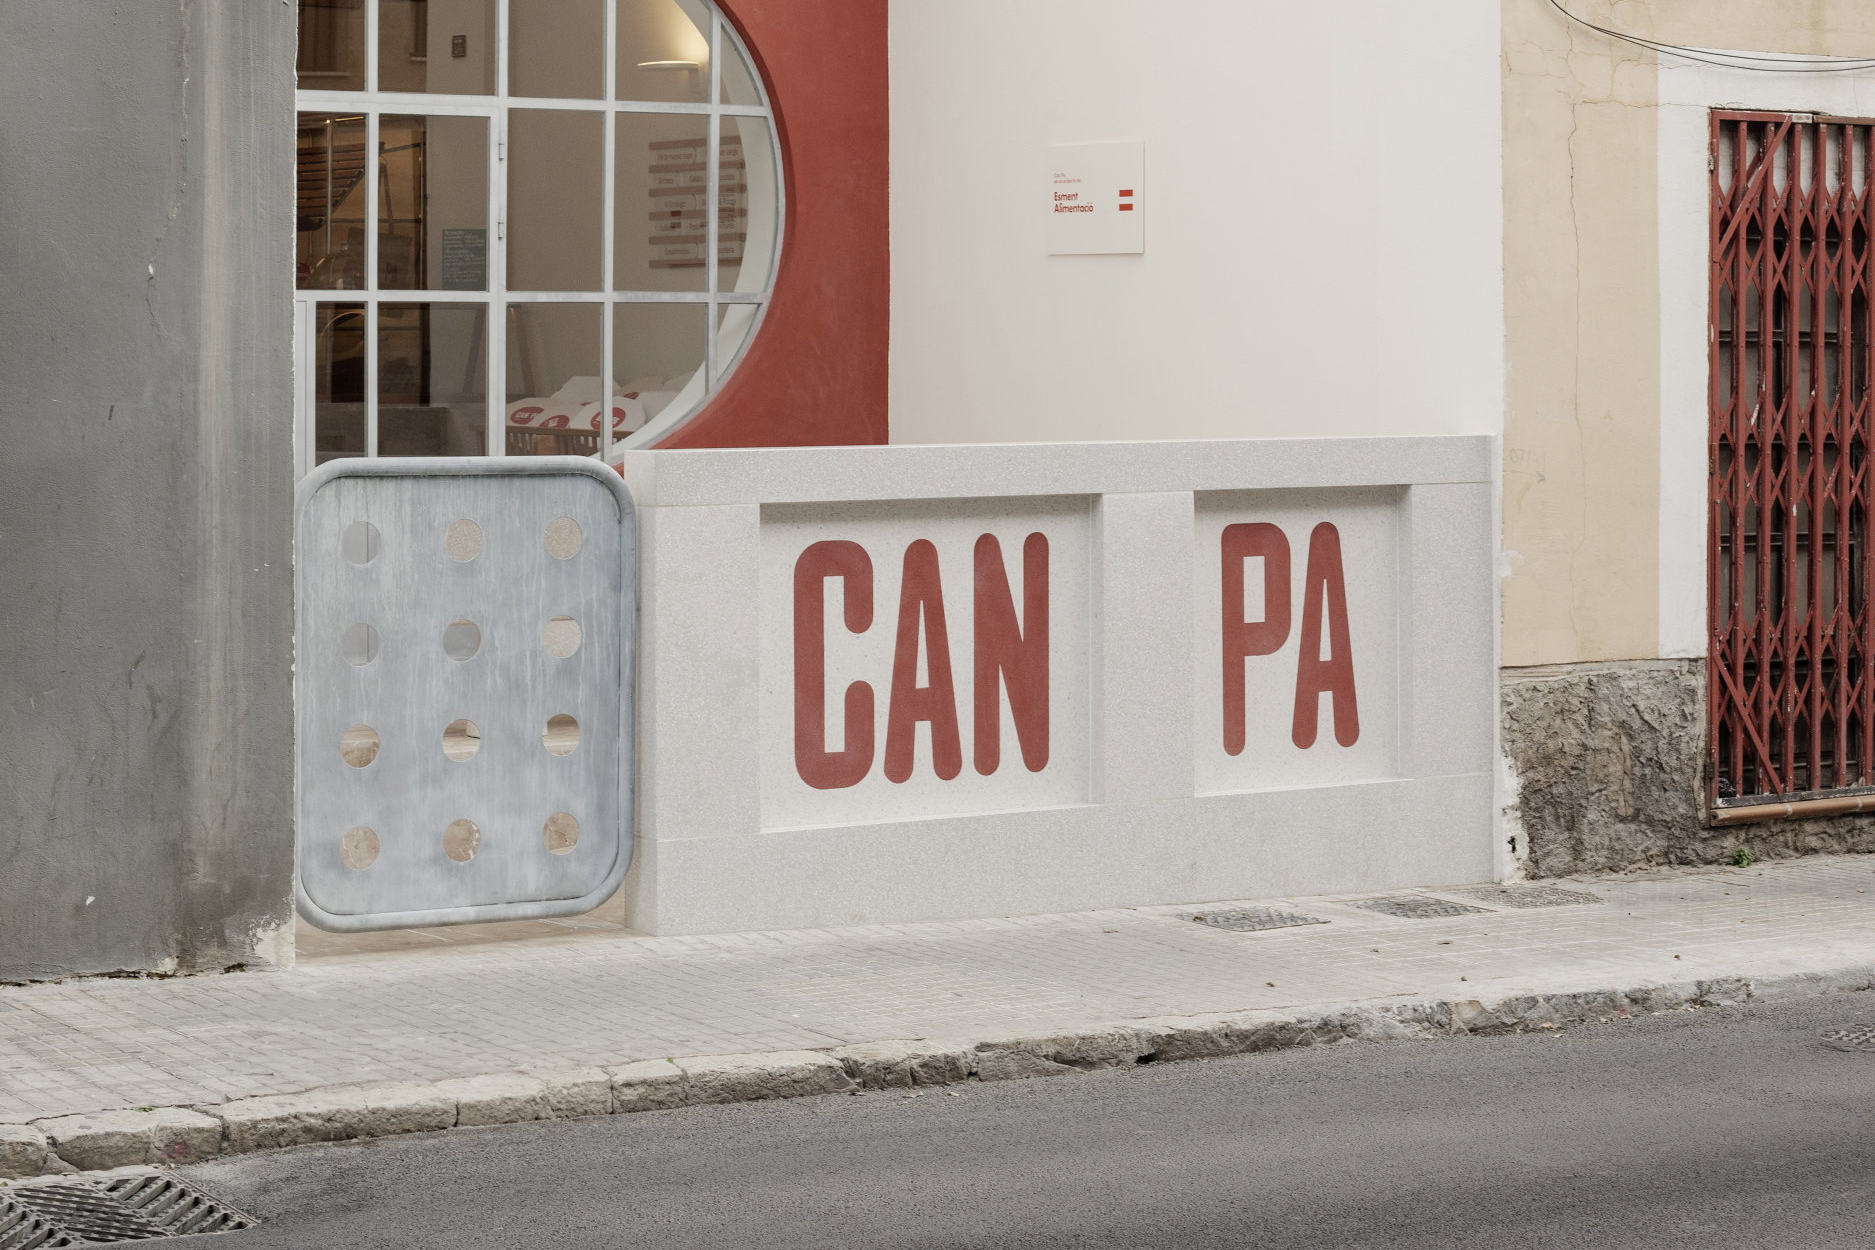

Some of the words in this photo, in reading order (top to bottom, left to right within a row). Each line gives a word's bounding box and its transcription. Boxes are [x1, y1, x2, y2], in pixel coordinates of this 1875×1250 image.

[1054, 191, 1078, 201] Esment
[794, 532, 1049, 789] CAN
[1221, 522, 1360, 756] PA
